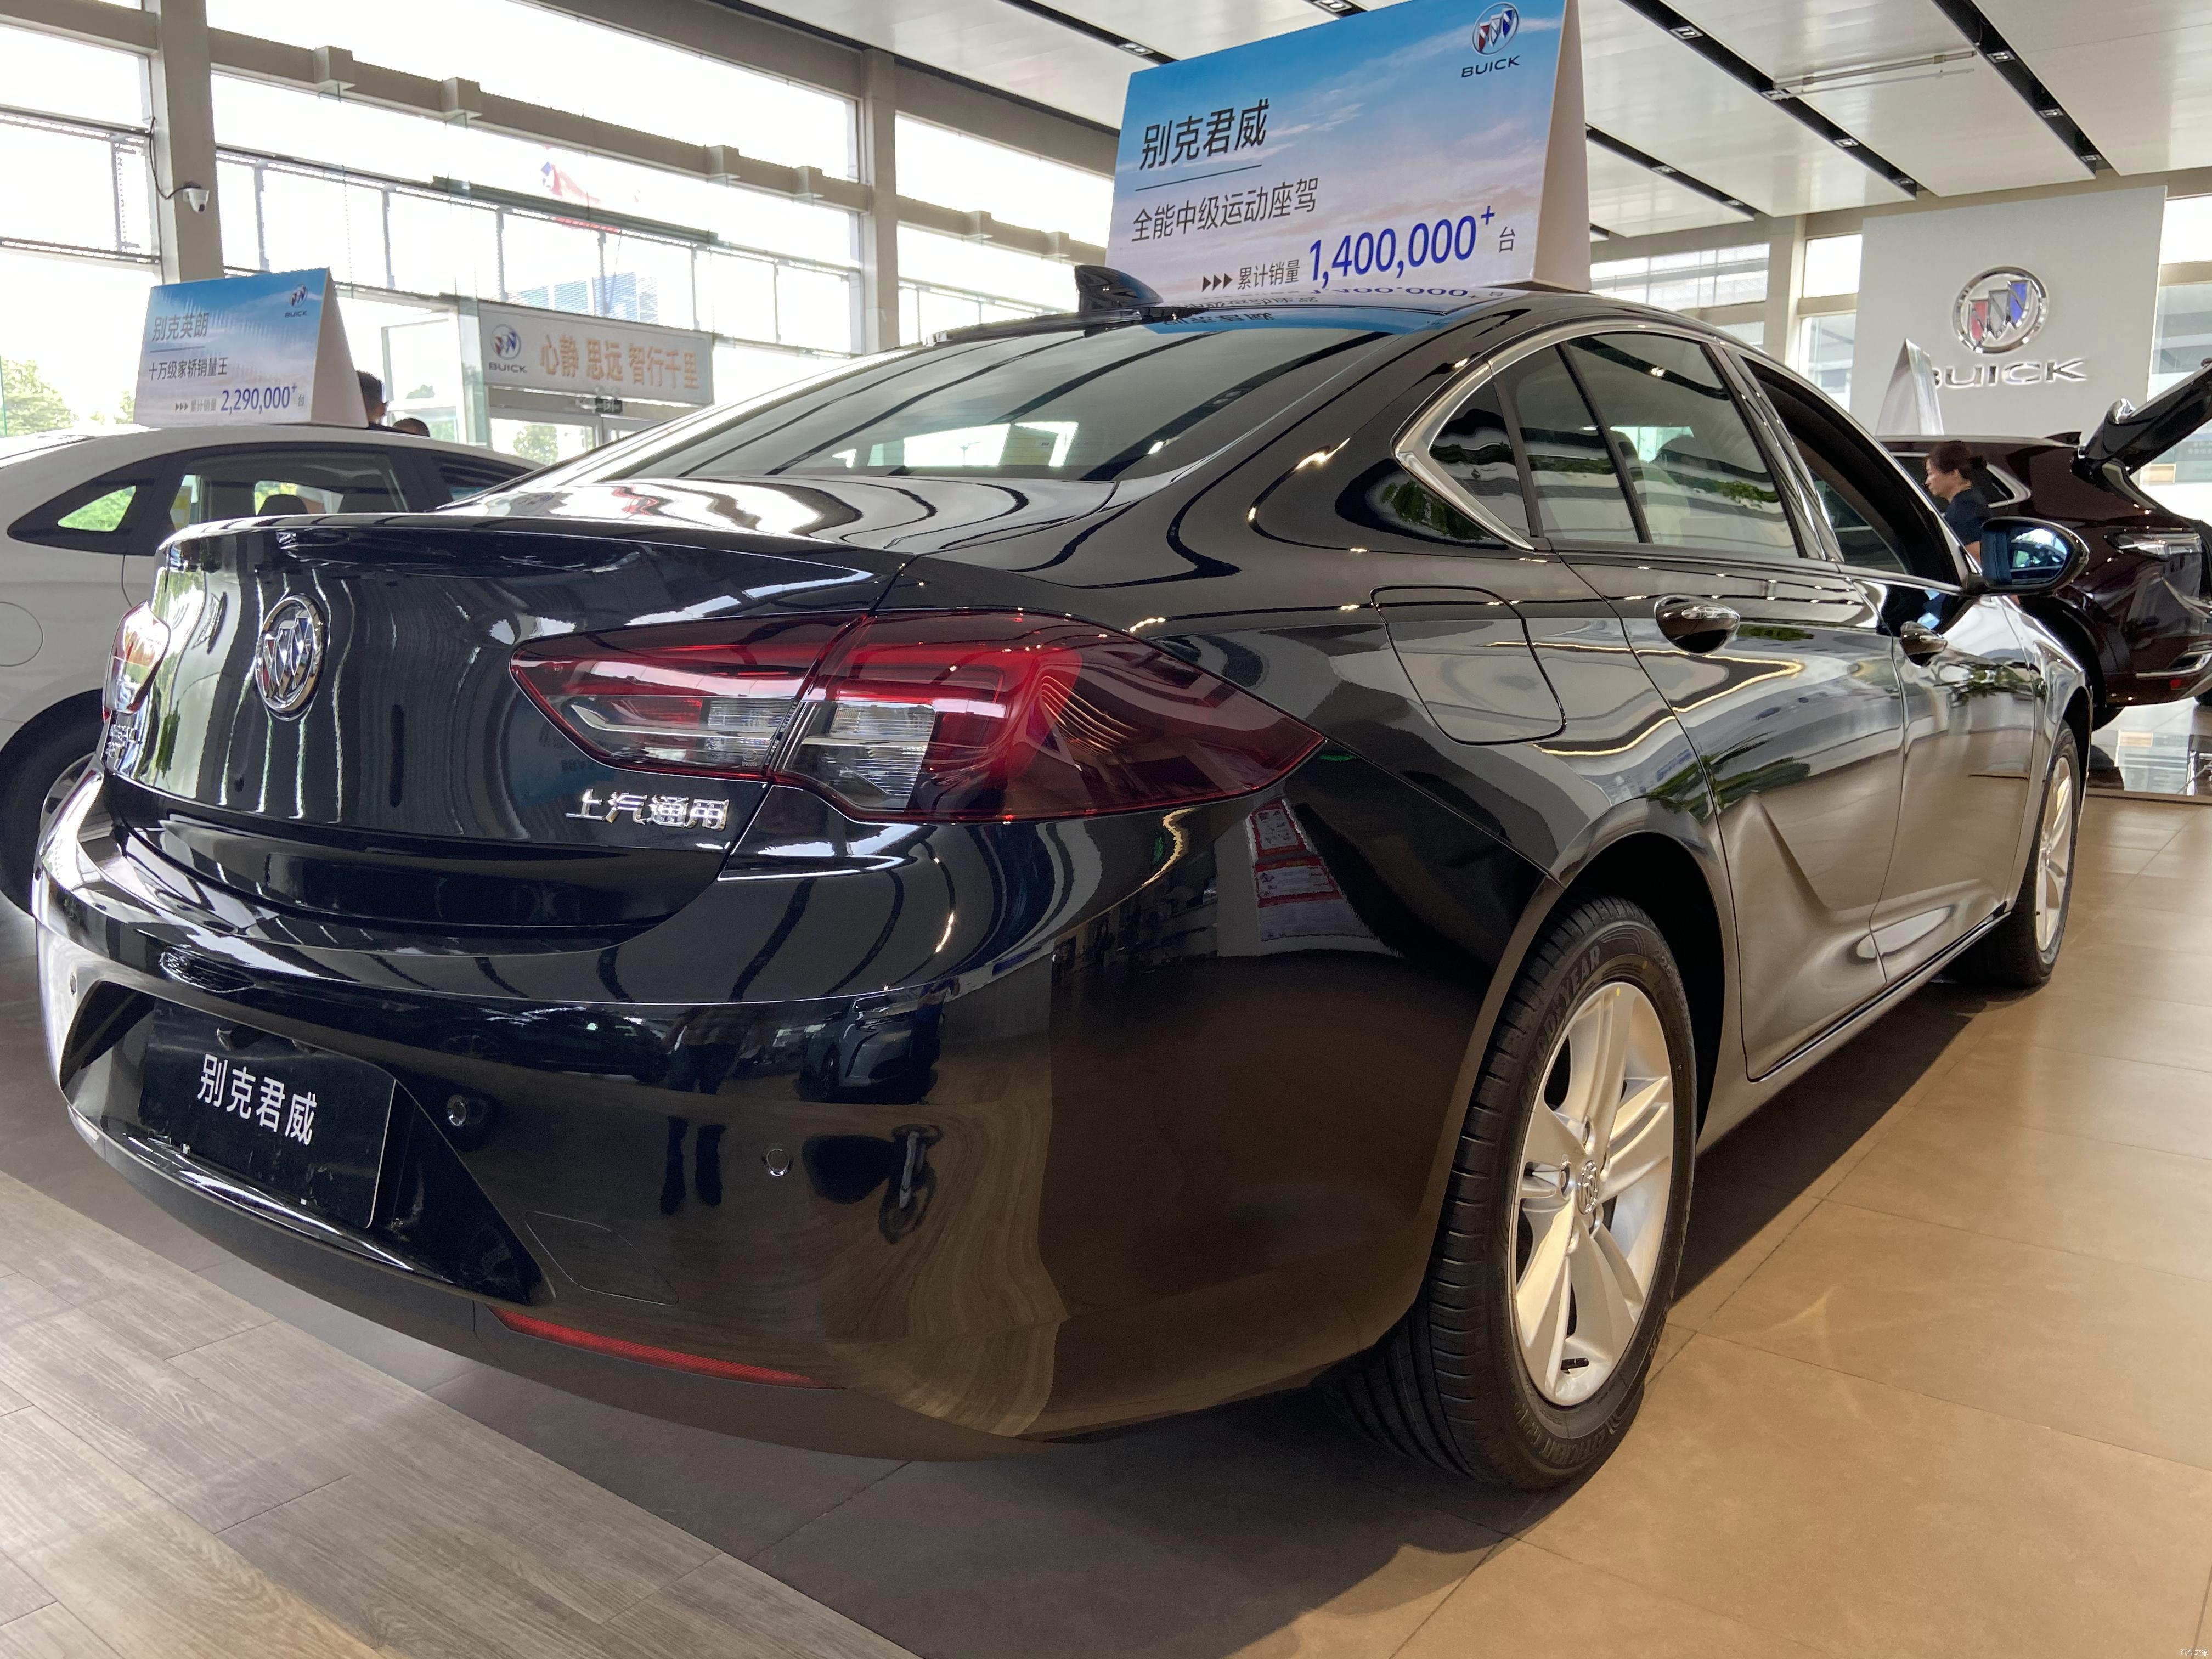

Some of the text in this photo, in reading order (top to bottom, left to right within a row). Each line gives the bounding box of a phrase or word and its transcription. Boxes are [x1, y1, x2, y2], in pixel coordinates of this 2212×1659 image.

[1461, 55, 1520, 78] BUICK
[1139, 98, 1269, 171] 别克君威
[1131, 178, 1318, 242] 全能中级运动座驾
[1238, 259, 1300, 290] 累计销量
[1499, 226, 1515, 253] 台
[151, 312, 209, 342] 别克英朗
[148, 357, 228, 381] 十万级家轿销量王
[488, 362, 527, 374] BUICK
[540, 334, 699, 390] 心静 思远 智行千里
[1932, 357, 2087, 388] UICK
[565, 788, 729, 832] 上汽通用
[198, 1053, 317, 1146] 别克君威
